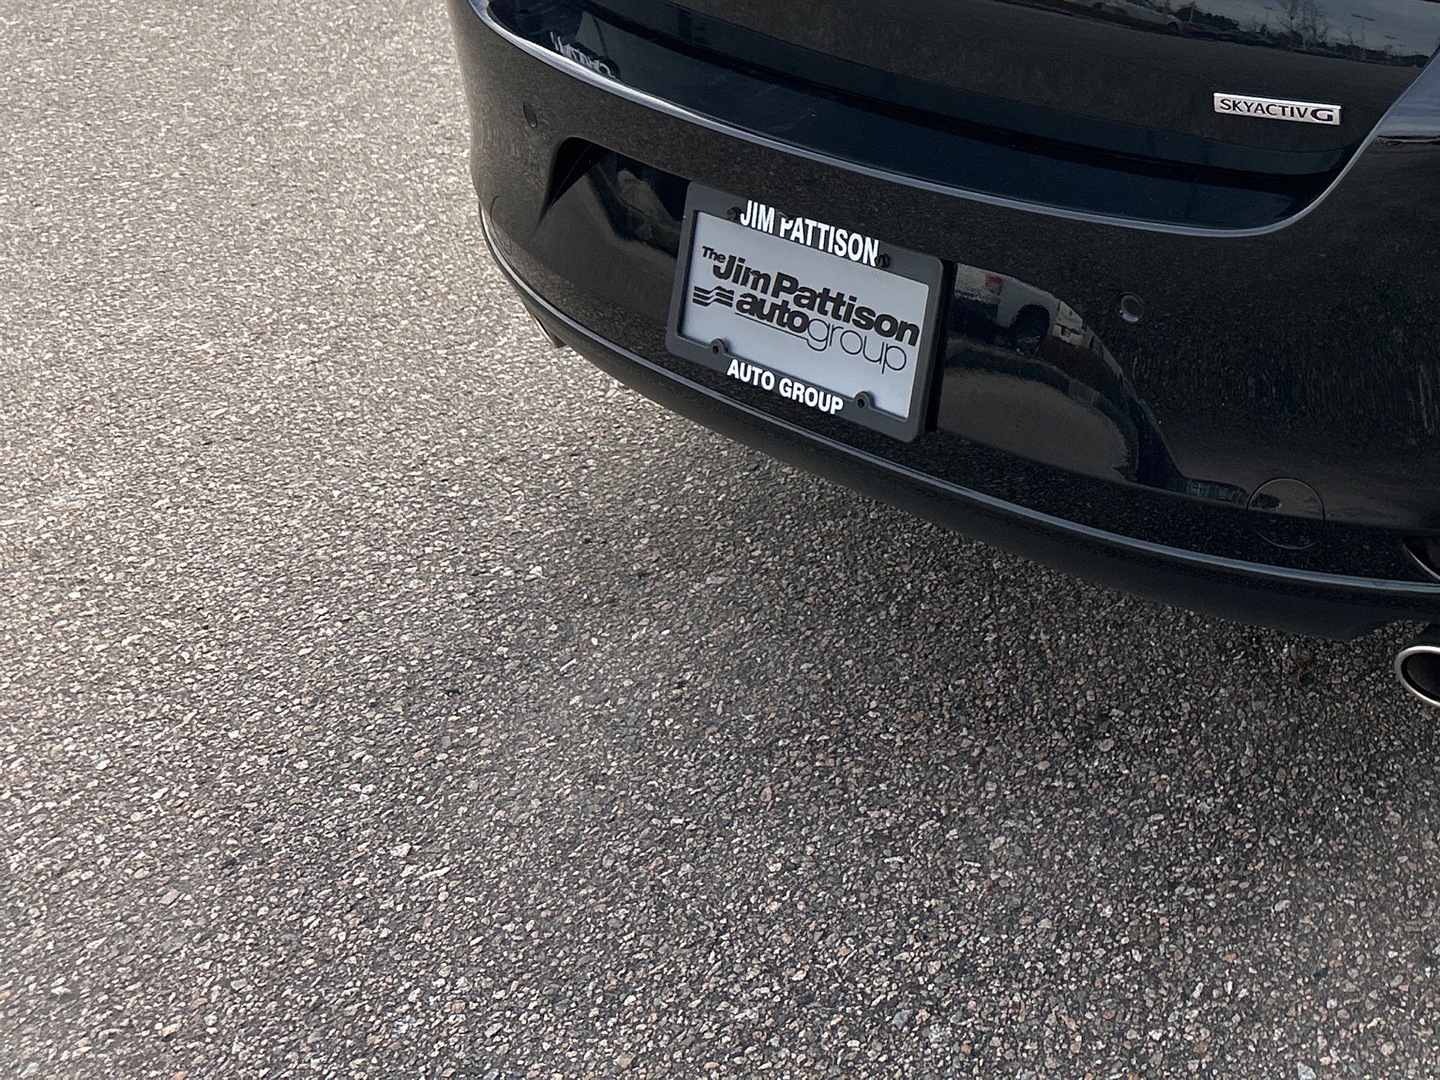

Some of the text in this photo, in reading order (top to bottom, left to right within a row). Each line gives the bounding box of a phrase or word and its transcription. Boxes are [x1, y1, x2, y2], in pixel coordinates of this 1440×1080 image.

[701, 245, 725, 264] The
[740, 200, 879, 267] JIM PATTISON
[726, 359, 844, 415] AUTO GROUP
